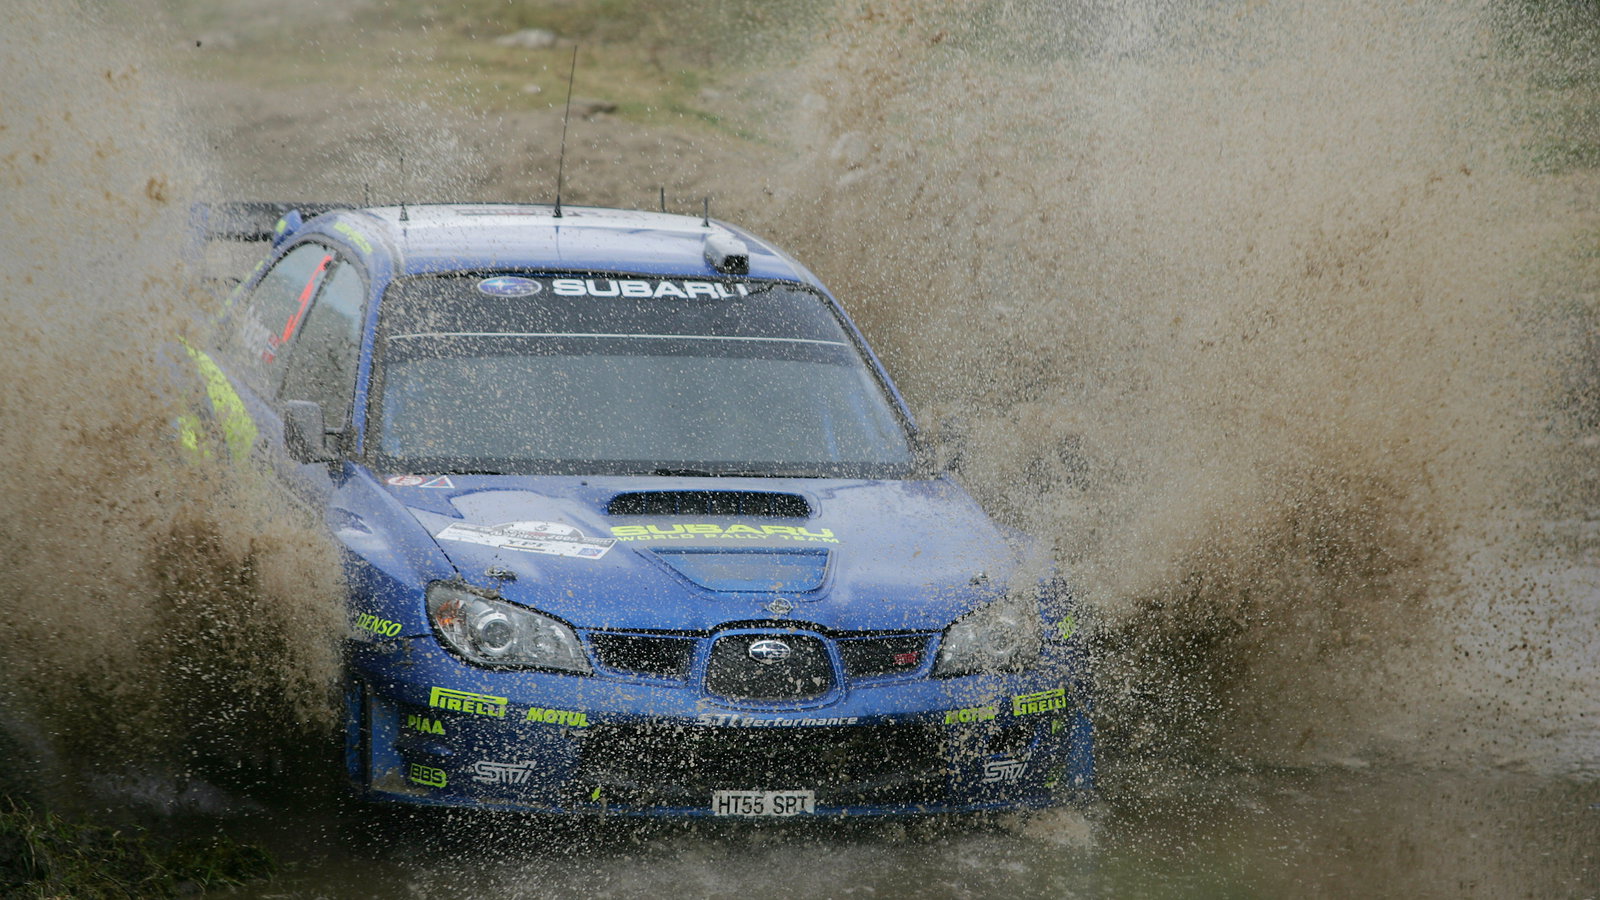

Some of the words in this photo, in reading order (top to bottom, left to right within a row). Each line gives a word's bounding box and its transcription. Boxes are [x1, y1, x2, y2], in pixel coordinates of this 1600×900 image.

[552, 279, 749, 299] SUBARU
[610, 523, 834, 538] SUBARU
[617, 534, 691, 542] WORLD
[779, 535, 840, 544] TEAM
[357, 612, 402, 637] DENSO
[429, 686, 508, 718] PIRELLI
[1012, 688, 1067, 716] PIRELLI
[408, 715, 446, 735] PIAA
[526, 707, 589, 728] MOTUL
[741, 716, 859, 728] Performance
[409, 763, 447, 788] BBS
[718, 795, 764, 815] HT55
